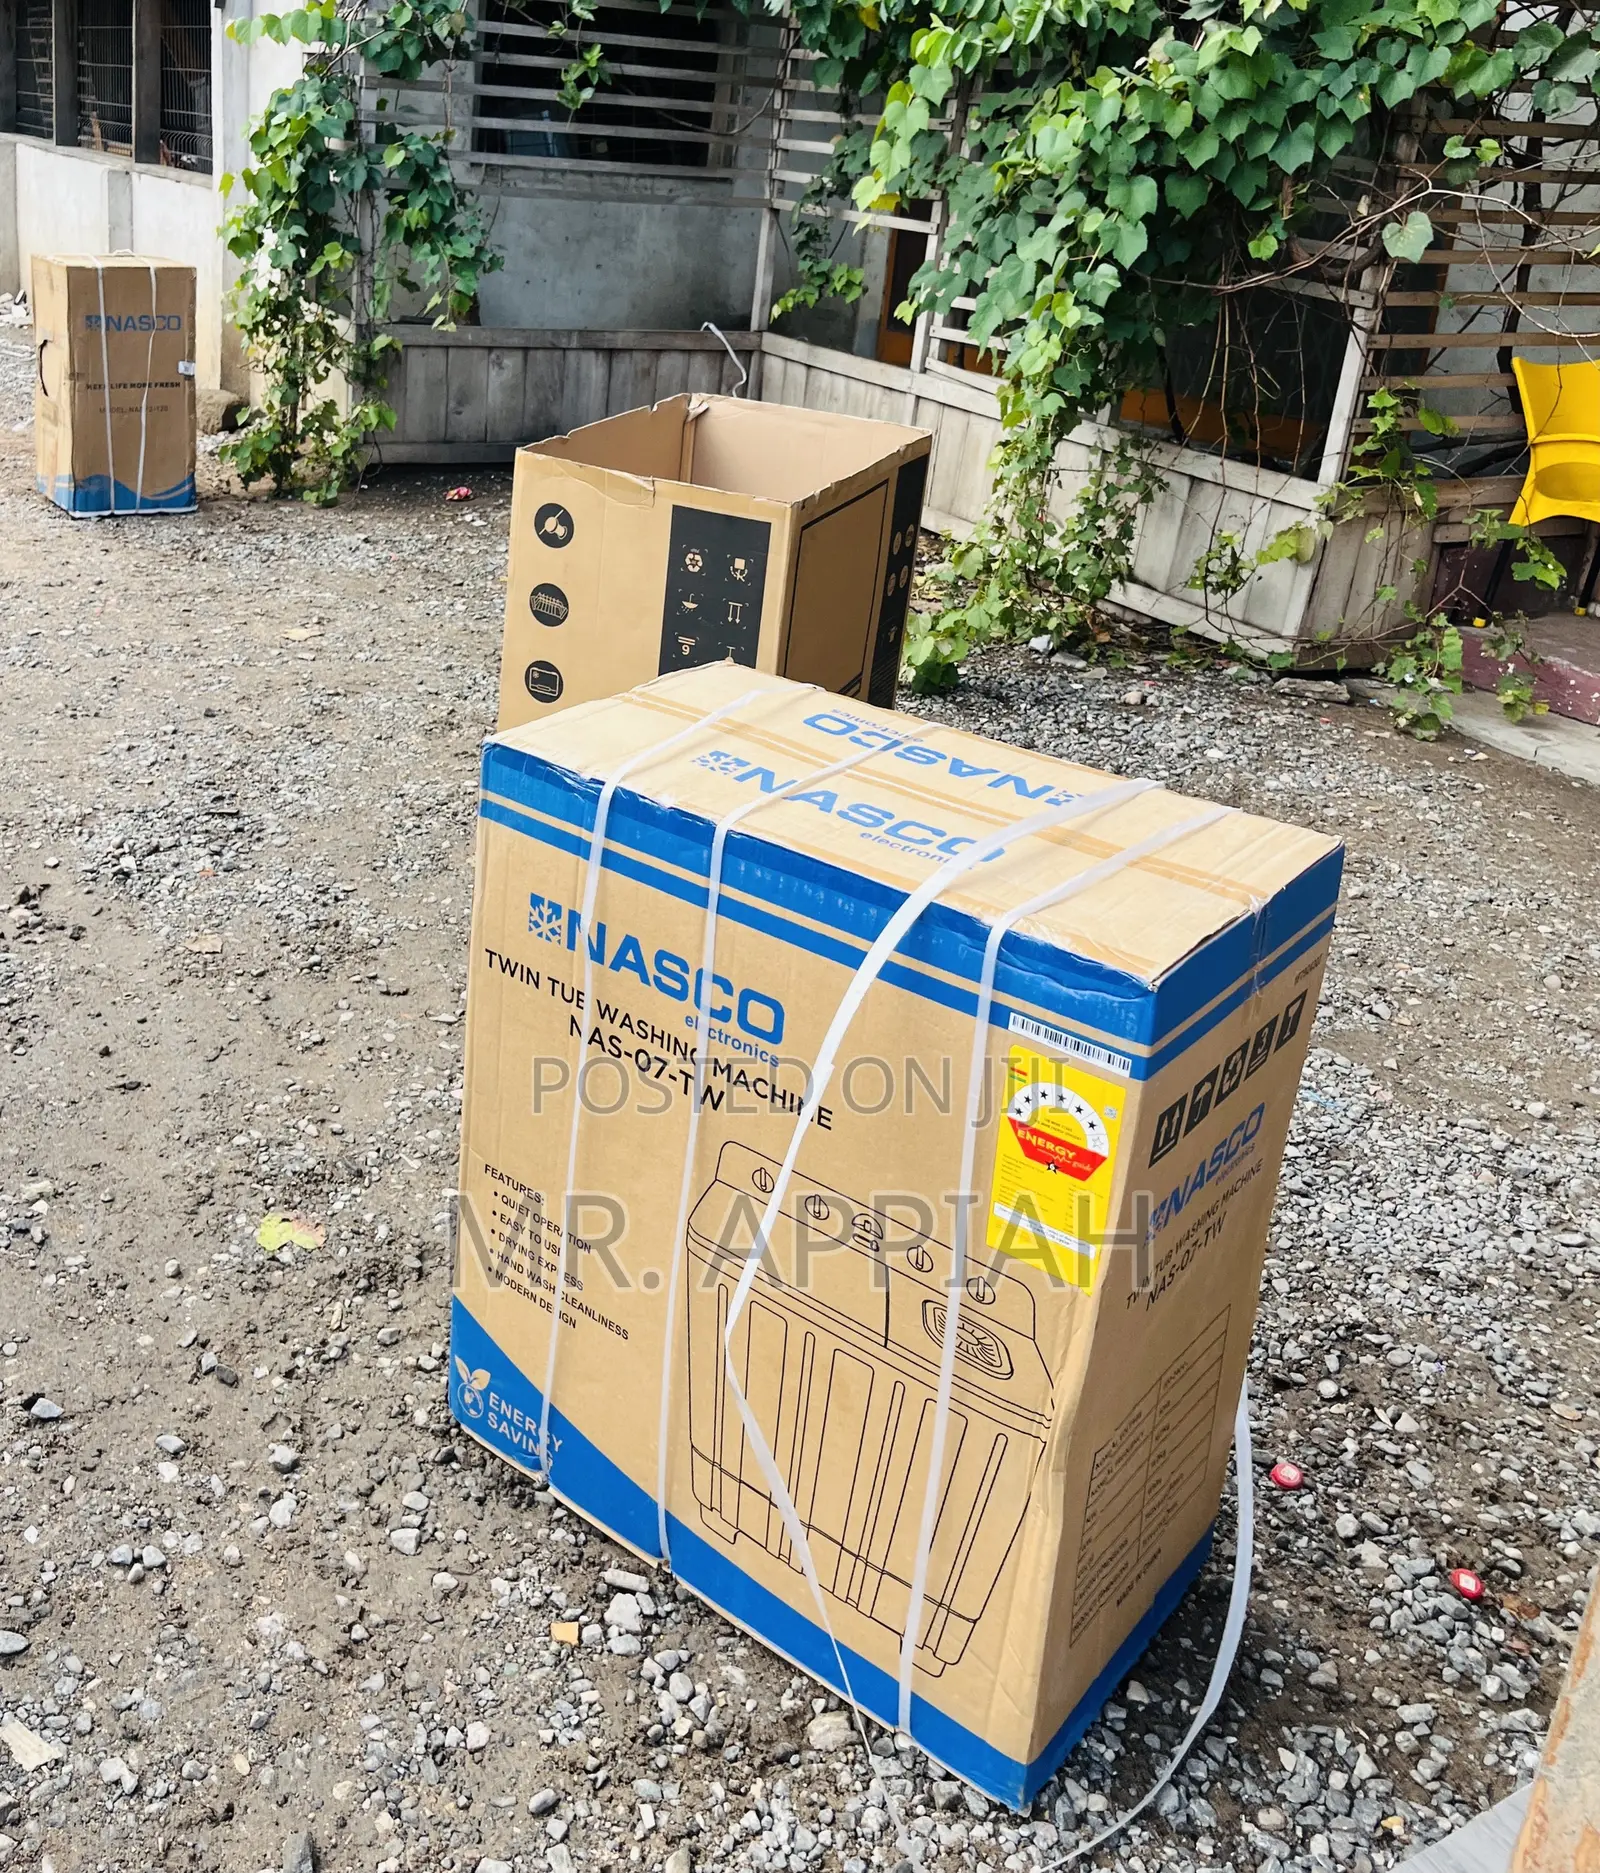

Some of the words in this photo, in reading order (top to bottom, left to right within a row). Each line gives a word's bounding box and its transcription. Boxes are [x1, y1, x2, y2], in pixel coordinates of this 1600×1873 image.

[104, 314, 182, 332] NASCO
[802, 713, 1055, 802] NASCO
[733, 766, 1006, 863] NASCO
[485, 947, 541, 990] TWIN
[566, 907, 785, 1045] NASCO
[684, 1015, 780, 1068] elctronics
[1017, 1128, 1077, 1160] ENERGY
[1163, 1102, 1266, 1230] NASCO
[484, 1163, 545, 1207] FEATURES:
[501, 1194, 531, 1219] QUIET
[499, 1213, 526, 1236] EASY
[529, 1229, 542, 1245] TO
[1126, 1271, 1152, 1310] TWIN
[1154, 1249, 1174, 1279] TUB
[1175, 1200, 1220, 1255] WASHING
[1220, 1158, 1264, 1206] MACHINE
[496, 1252, 524, 1275] HAND
[526, 1269, 557, 1296] WASH
[498, 1232, 536, 1261] DRYING
[537, 1255, 585, 1292] EXPESS
[1145, 1211, 1228, 1312] NAS-07-TW
[495, 1270, 537, 1304] MODERN
[539, 1297, 578, 1330] DEIGN
